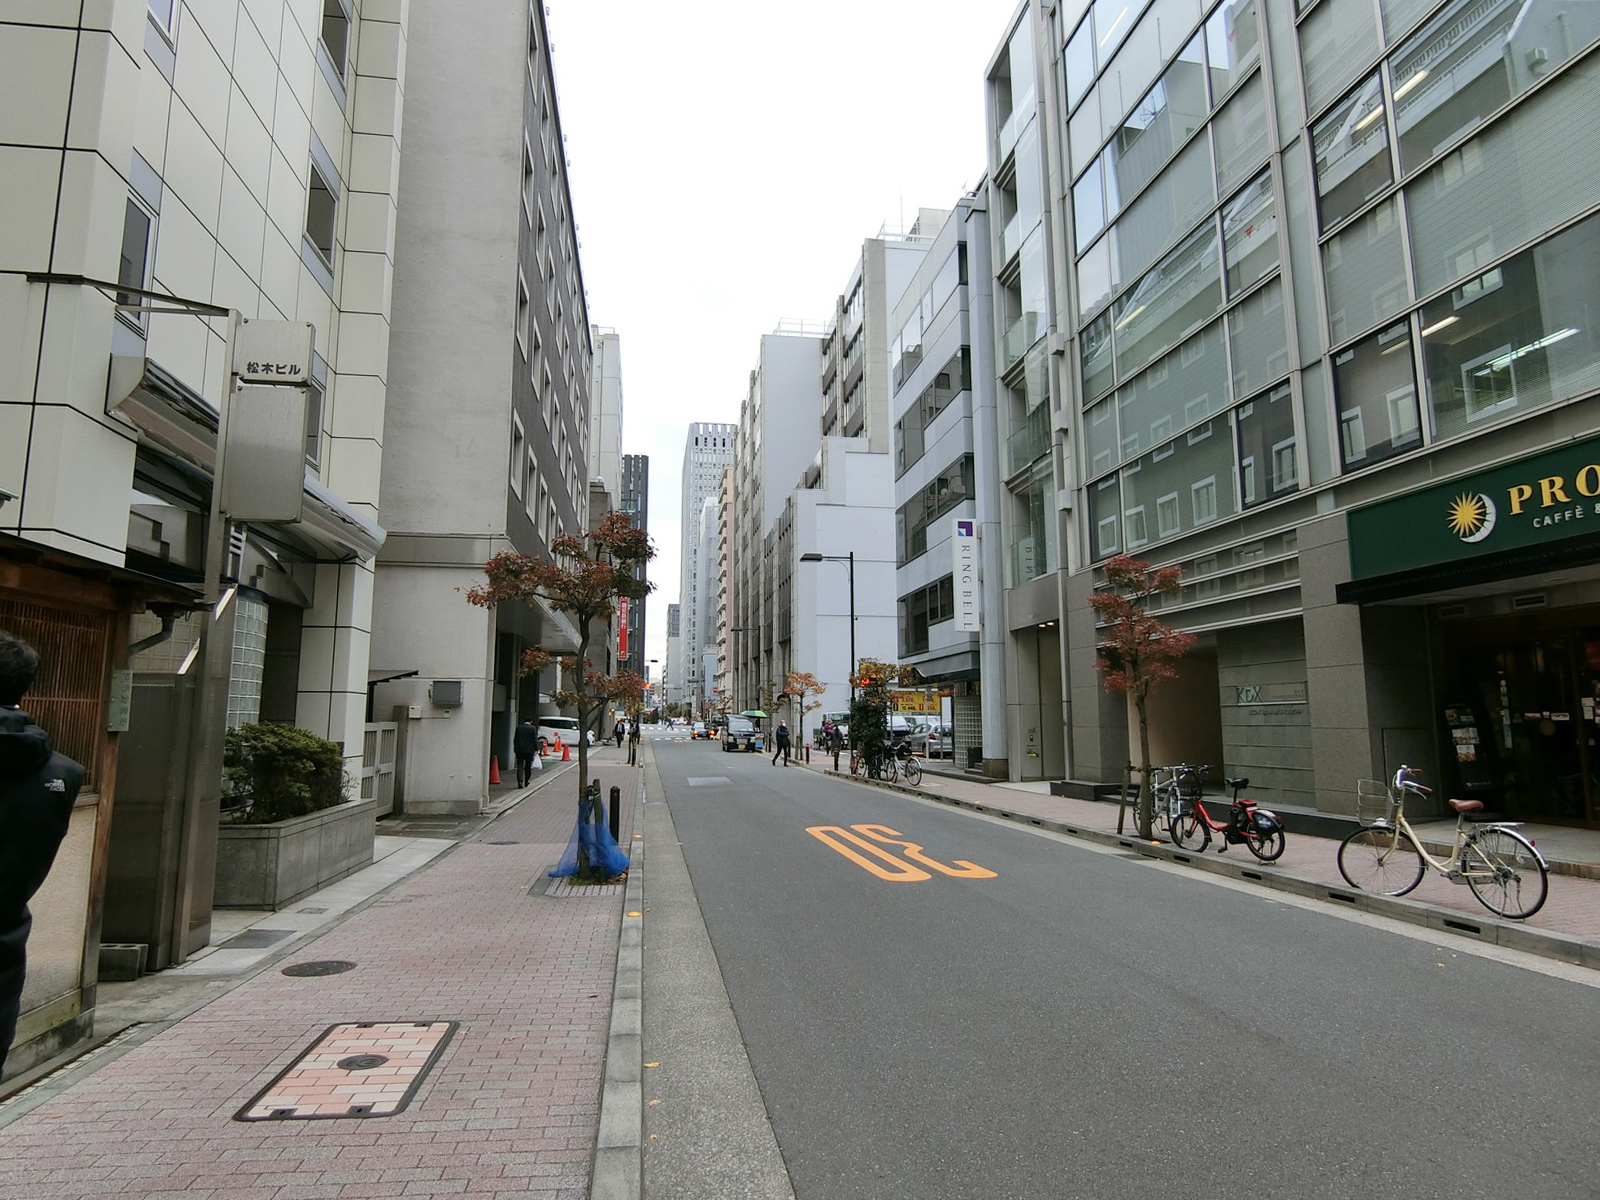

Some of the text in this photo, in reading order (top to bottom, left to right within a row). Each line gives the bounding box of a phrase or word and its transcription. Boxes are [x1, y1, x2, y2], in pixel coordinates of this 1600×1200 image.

[247, 361, 301, 375] 松木ビル
[1532, 505, 1584, 528] CAFFÈ
[961, 545, 973, 629] RINGBELL
[1238, 686, 1263, 703] KDX
